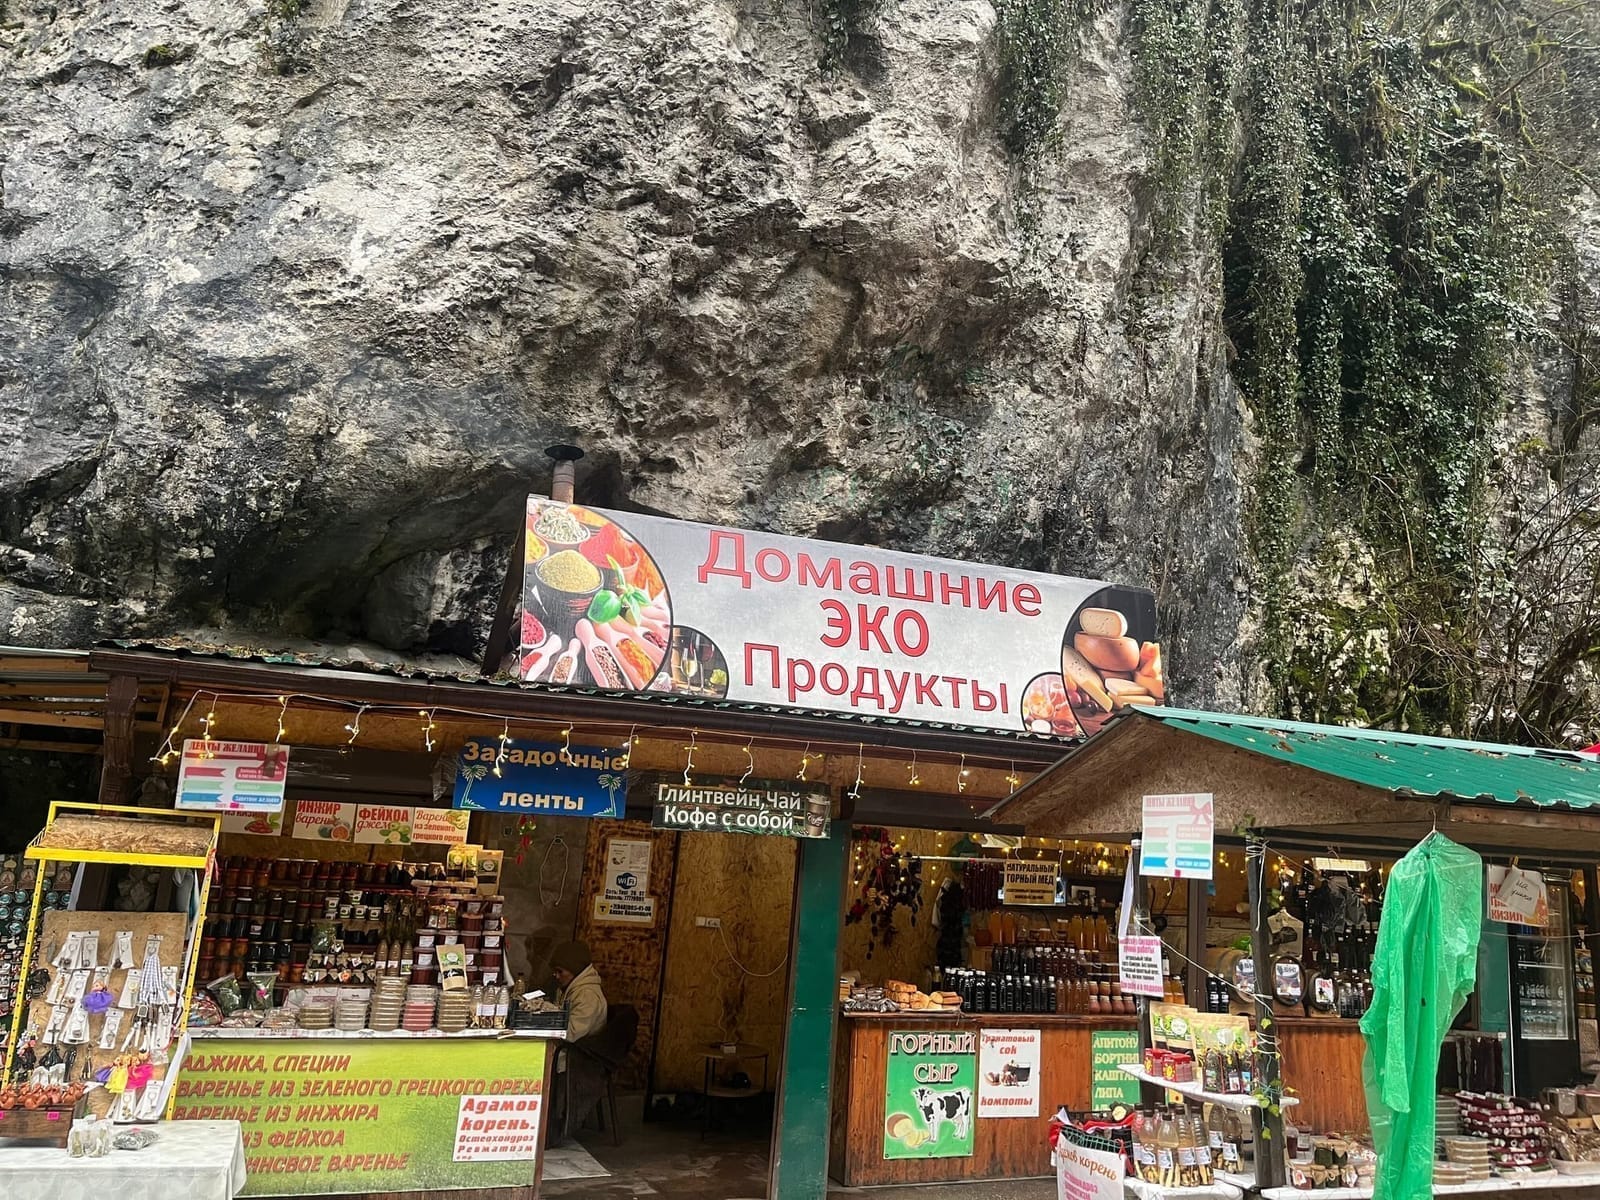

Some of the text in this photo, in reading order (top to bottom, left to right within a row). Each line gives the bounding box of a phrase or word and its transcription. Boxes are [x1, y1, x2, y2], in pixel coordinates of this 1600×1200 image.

[697, 529, 1042, 617] Домашние
[820, 598, 930, 658] ЭКО
[743, 642, 1009, 715] Продукты
[463, 741, 627, 771] Загадочные
[298, 801, 341, 815] ИНЖИР
[499, 791, 584, 810] ленты
[359, 807, 409, 822] ФЕЙХОА
[664, 805, 793, 830] Кофе с собой
[1006, 864, 1055, 873] НАТУРАЛЬНЫЙ
[1006, 873, 1054, 886] ГОРНЫЙ МЕД
[1491, 909, 1523, 923] КИЗИЛ
[890, 1032, 976, 1055] ГОРНЫЙ
[982, 1034, 1035, 1044] Гранатовый
[1094, 1037, 1139, 1048] АПИТОНУ
[1000, 1046, 1016, 1055] сок
[180, 1055, 351, 1074] АДЖИКА, СПЕЦИИ
[914, 1063, 959, 1083] СЫР
[176, 1079, 543, 1097] ВАРЕНЬЕ ИЗ ЗЕЛЕНОГО ГРЕЦКОГО ОРЕХА
[1095, 1087, 1123, 1098] ЛИПА
[173, 1103, 380, 1122] ВАРЕНЬЕ ИЗ ИНЖИРА
[462, 1098, 538, 1114] Адамов
[268, 1128, 345, 1148] ФЕЙХОА
[459, 1135, 534, 1143] Остеохондроз
[457, 1145, 532, 1153] Ревматизм
[327, 1152, 410, 1172] ВАРЕНЬЕ
[1080, 1156, 1117, 1181] корень
